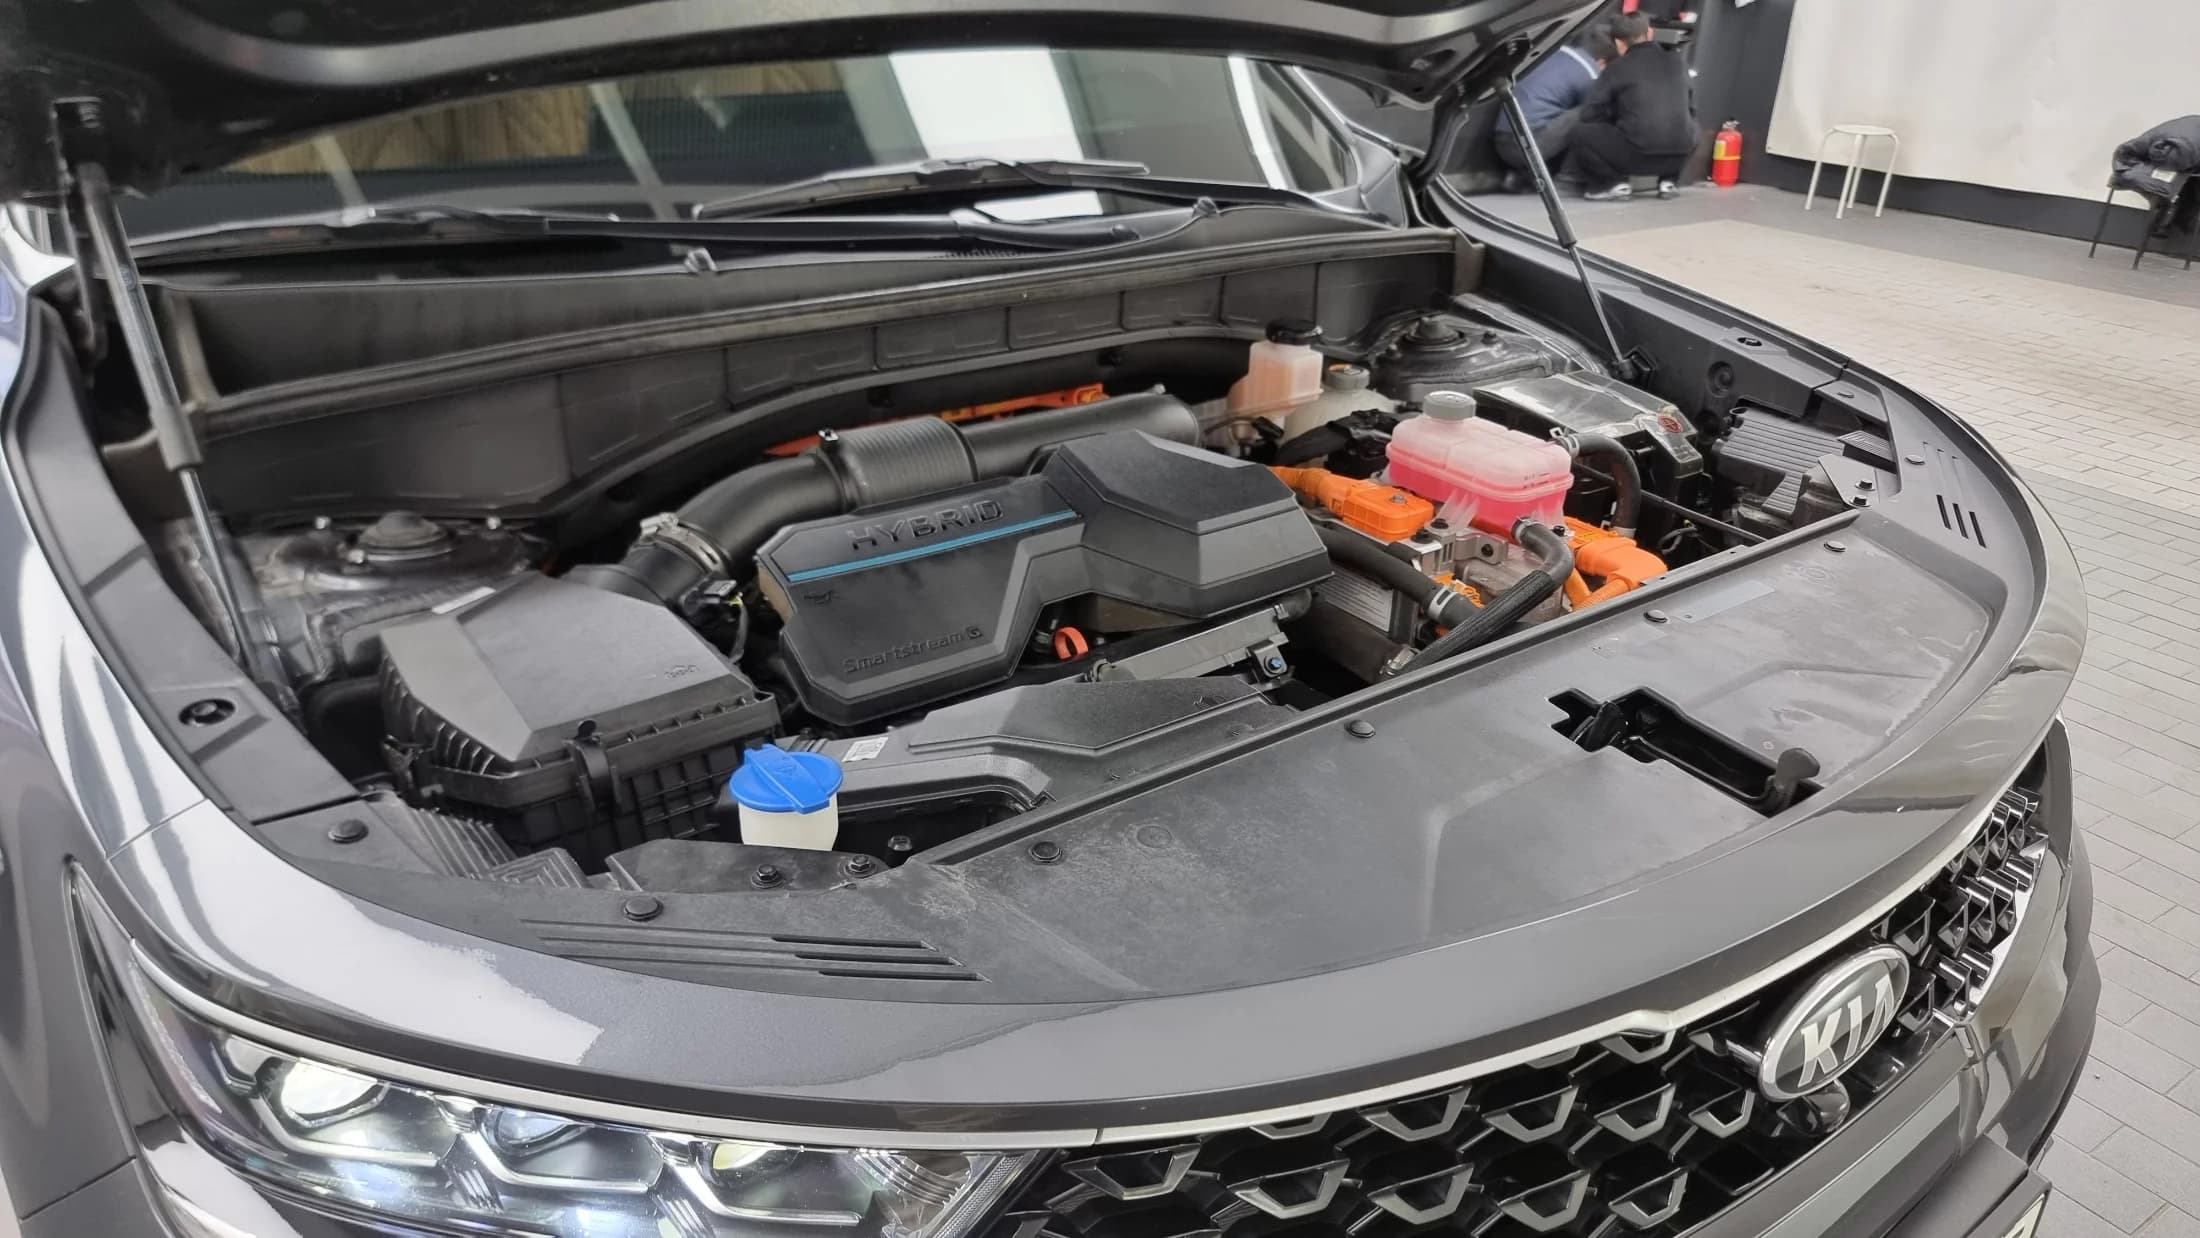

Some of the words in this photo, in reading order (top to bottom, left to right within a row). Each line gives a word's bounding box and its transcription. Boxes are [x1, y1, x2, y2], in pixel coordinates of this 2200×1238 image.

[846, 500, 1004, 550] HYBRID
[843, 631, 964, 673] Smartstream
[1797, 973, 1896, 1089] KIA
